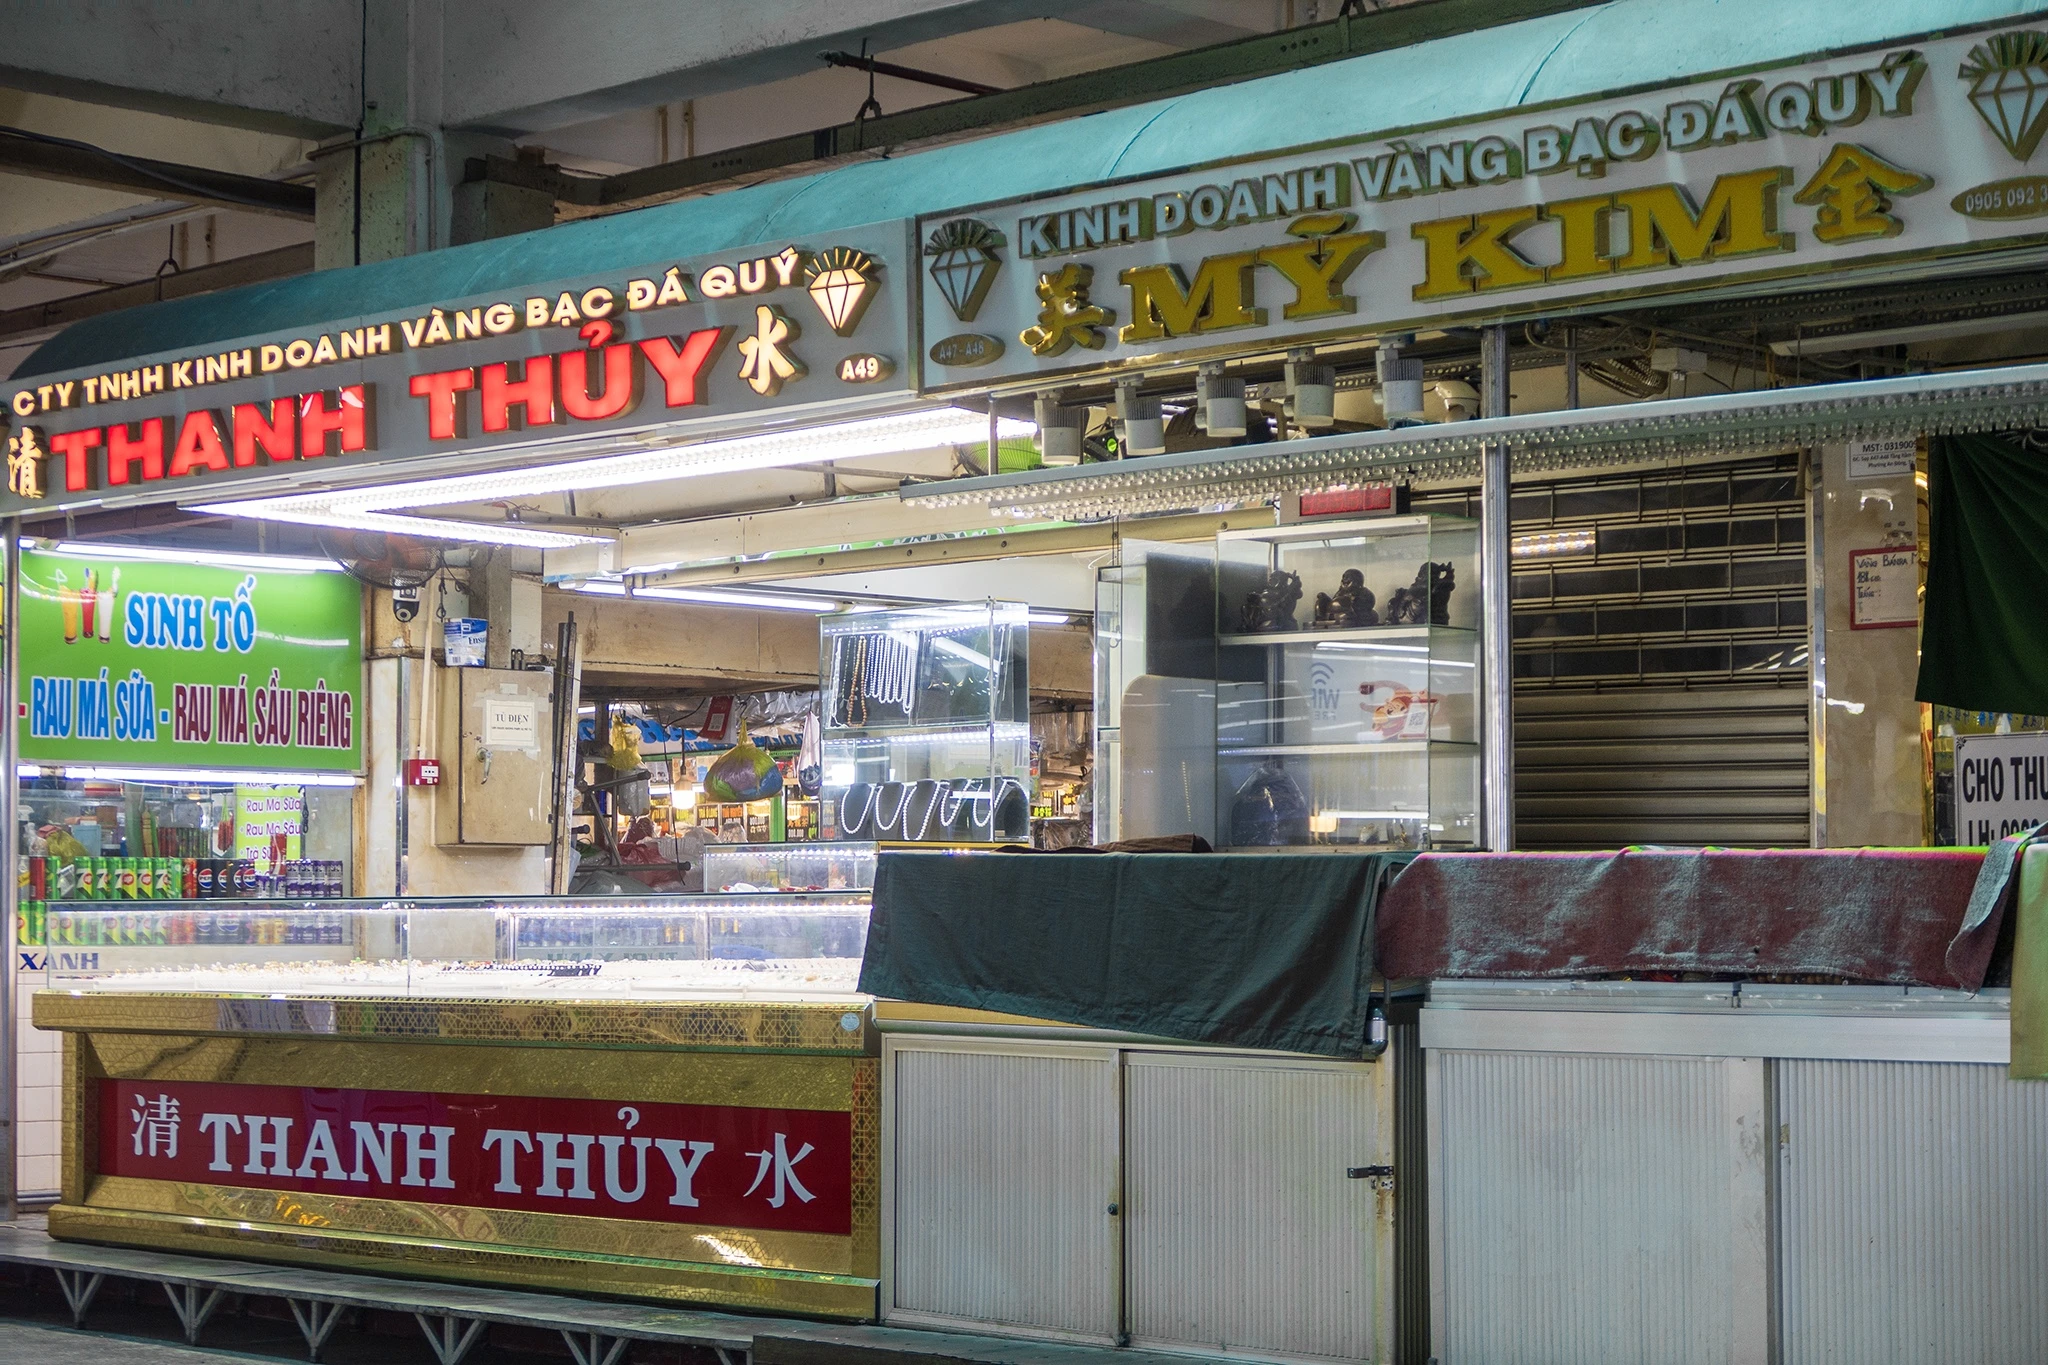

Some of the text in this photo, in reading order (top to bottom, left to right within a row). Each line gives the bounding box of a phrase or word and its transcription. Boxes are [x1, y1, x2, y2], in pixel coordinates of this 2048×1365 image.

[1019, 51, 1919, 258] KINH DOANH VÀNG BẠC ĐÁ QUÝ
[1795, 143, 1934, 244] 金
[1965, 190, 2002, 213] 0905
[2006, 186, 2035, 208] 092
[1119, 166, 1793, 344] MỸ KIM
[13, 246, 800, 417] CTY TNHH KINH DOANH VÀNG BẠC ĐÁ QUÝ
[738, 305, 797, 395] 水
[841, 356, 880, 381] A49
[50, 319, 723, 493] THANH THỦY
[7, 426, 47, 499] 清
[1863, 443, 1883, 453] MST:
[126, 575, 256, 652] SINH TỐ
[32, 668, 352, 749] RAU MÁ SỮA RAU MÁ SẦU RIÊNG
[246, 800, 263, 812] Rau
[266, 798, 280, 811] Má
[1962, 757, 2004, 803] CHO
[246, 823, 263, 836] Rau
[19, 952, 100, 971] XANH
[130, 1093, 181, 1160] 清
[199, 1106, 715, 1209] THANH THỦY
[743, 1133, 818, 1209] 水
